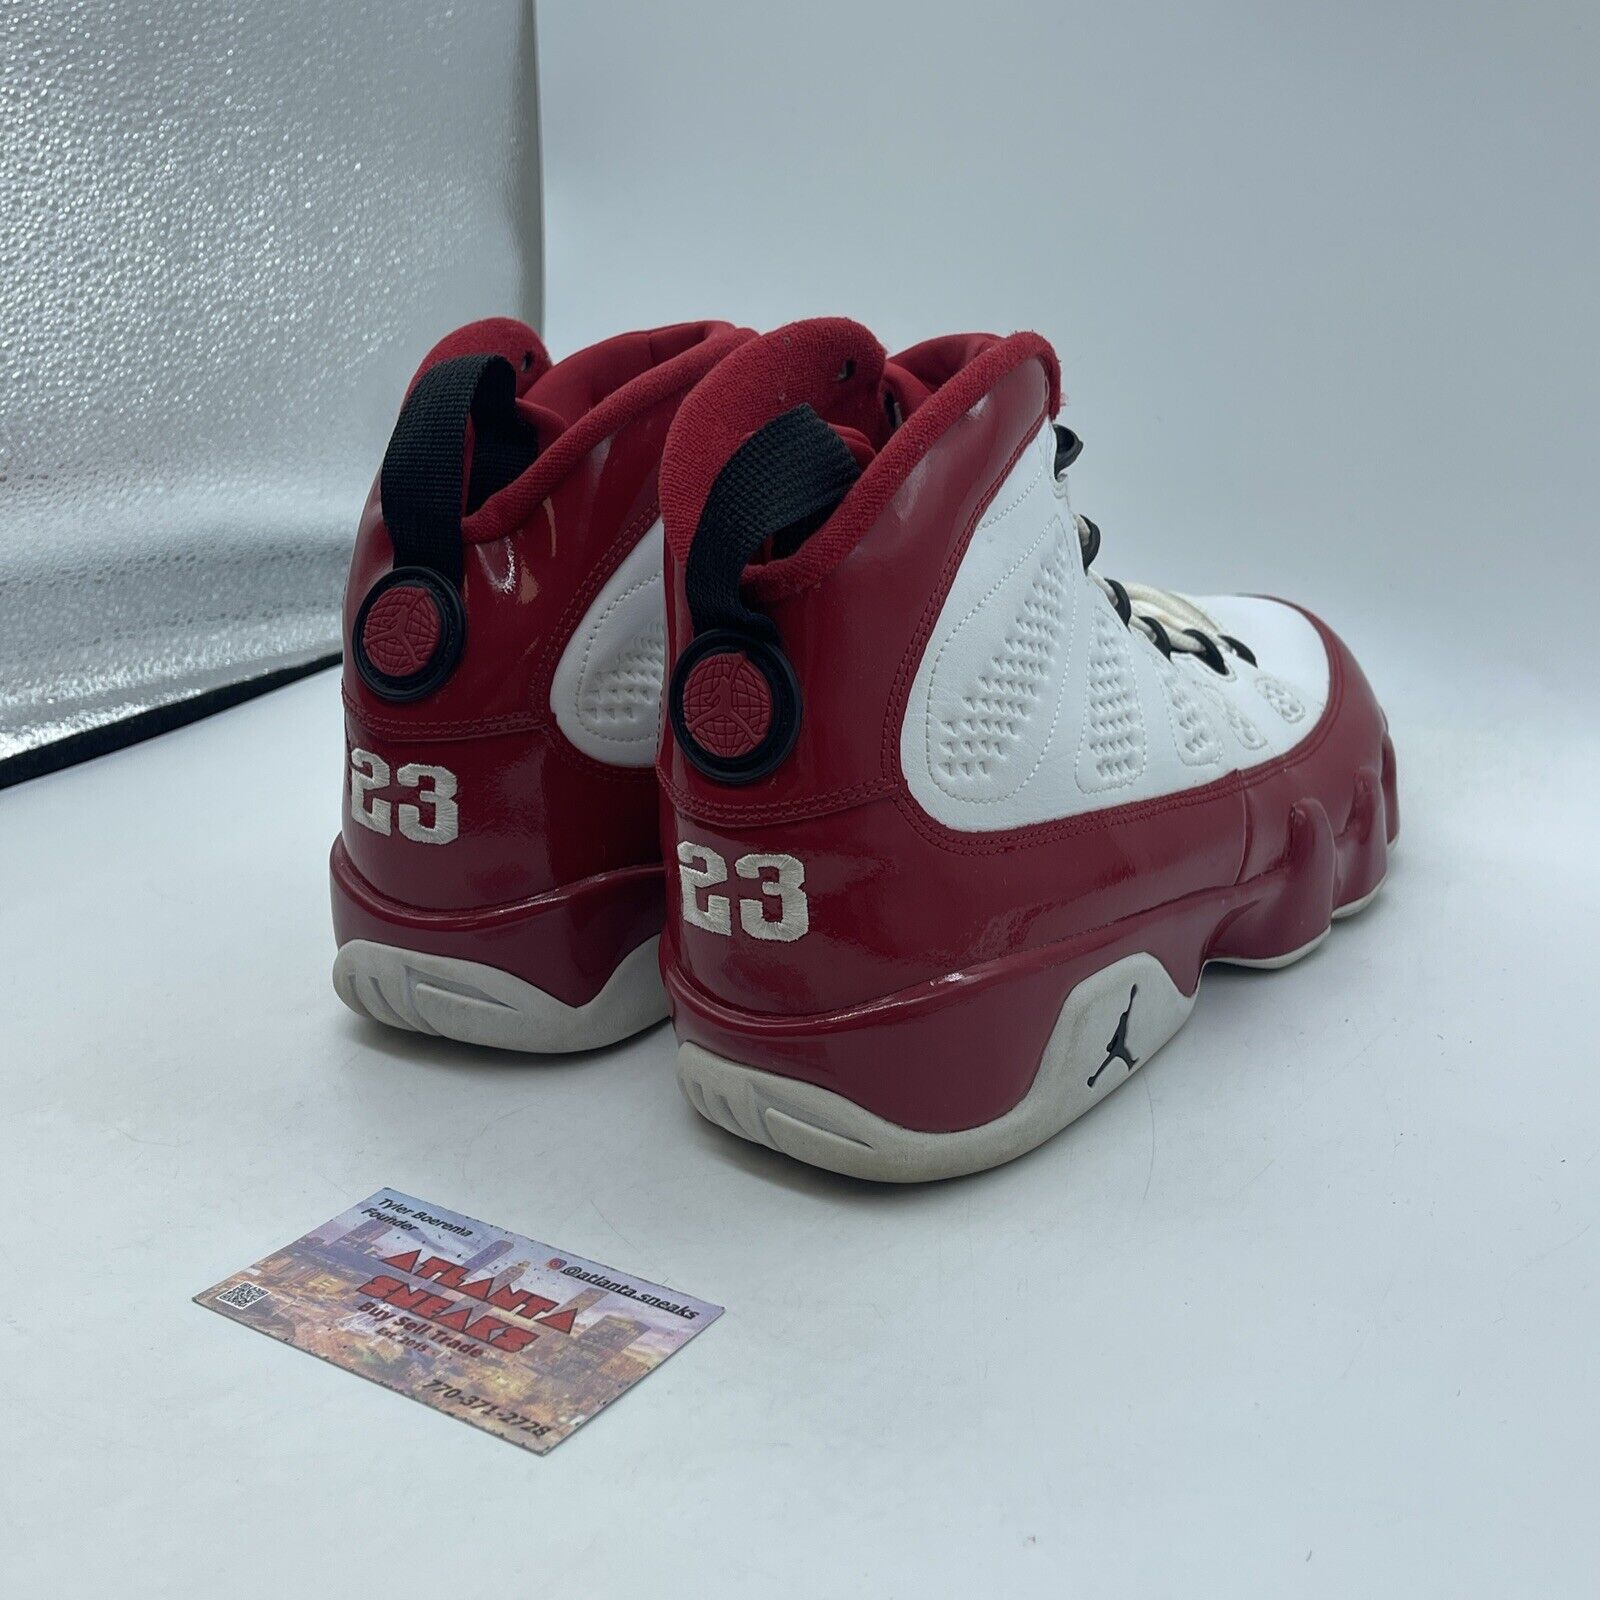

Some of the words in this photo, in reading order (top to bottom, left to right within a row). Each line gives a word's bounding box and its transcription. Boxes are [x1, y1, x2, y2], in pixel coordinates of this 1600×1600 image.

[351, 747, 459, 845] 23
[676, 841, 809, 942] 23
[361, 1207, 419, 1231] Founder
[378, 1198, 414, 1215] Tyler
[411, 1211, 474, 1237] Boerema
[356, 1275, 540, 1353] SNEAKS
[380, 1249, 578, 1335] ATLANTA
[560, 1266, 699, 1319] @atlanta.sneaks
[357, 1301, 396, 1322] Buy
[392, 1316, 433, 1334] Sell
[430, 1330, 484, 1358] Trade
[422, 1379, 552, 1437] 770-371-2728
